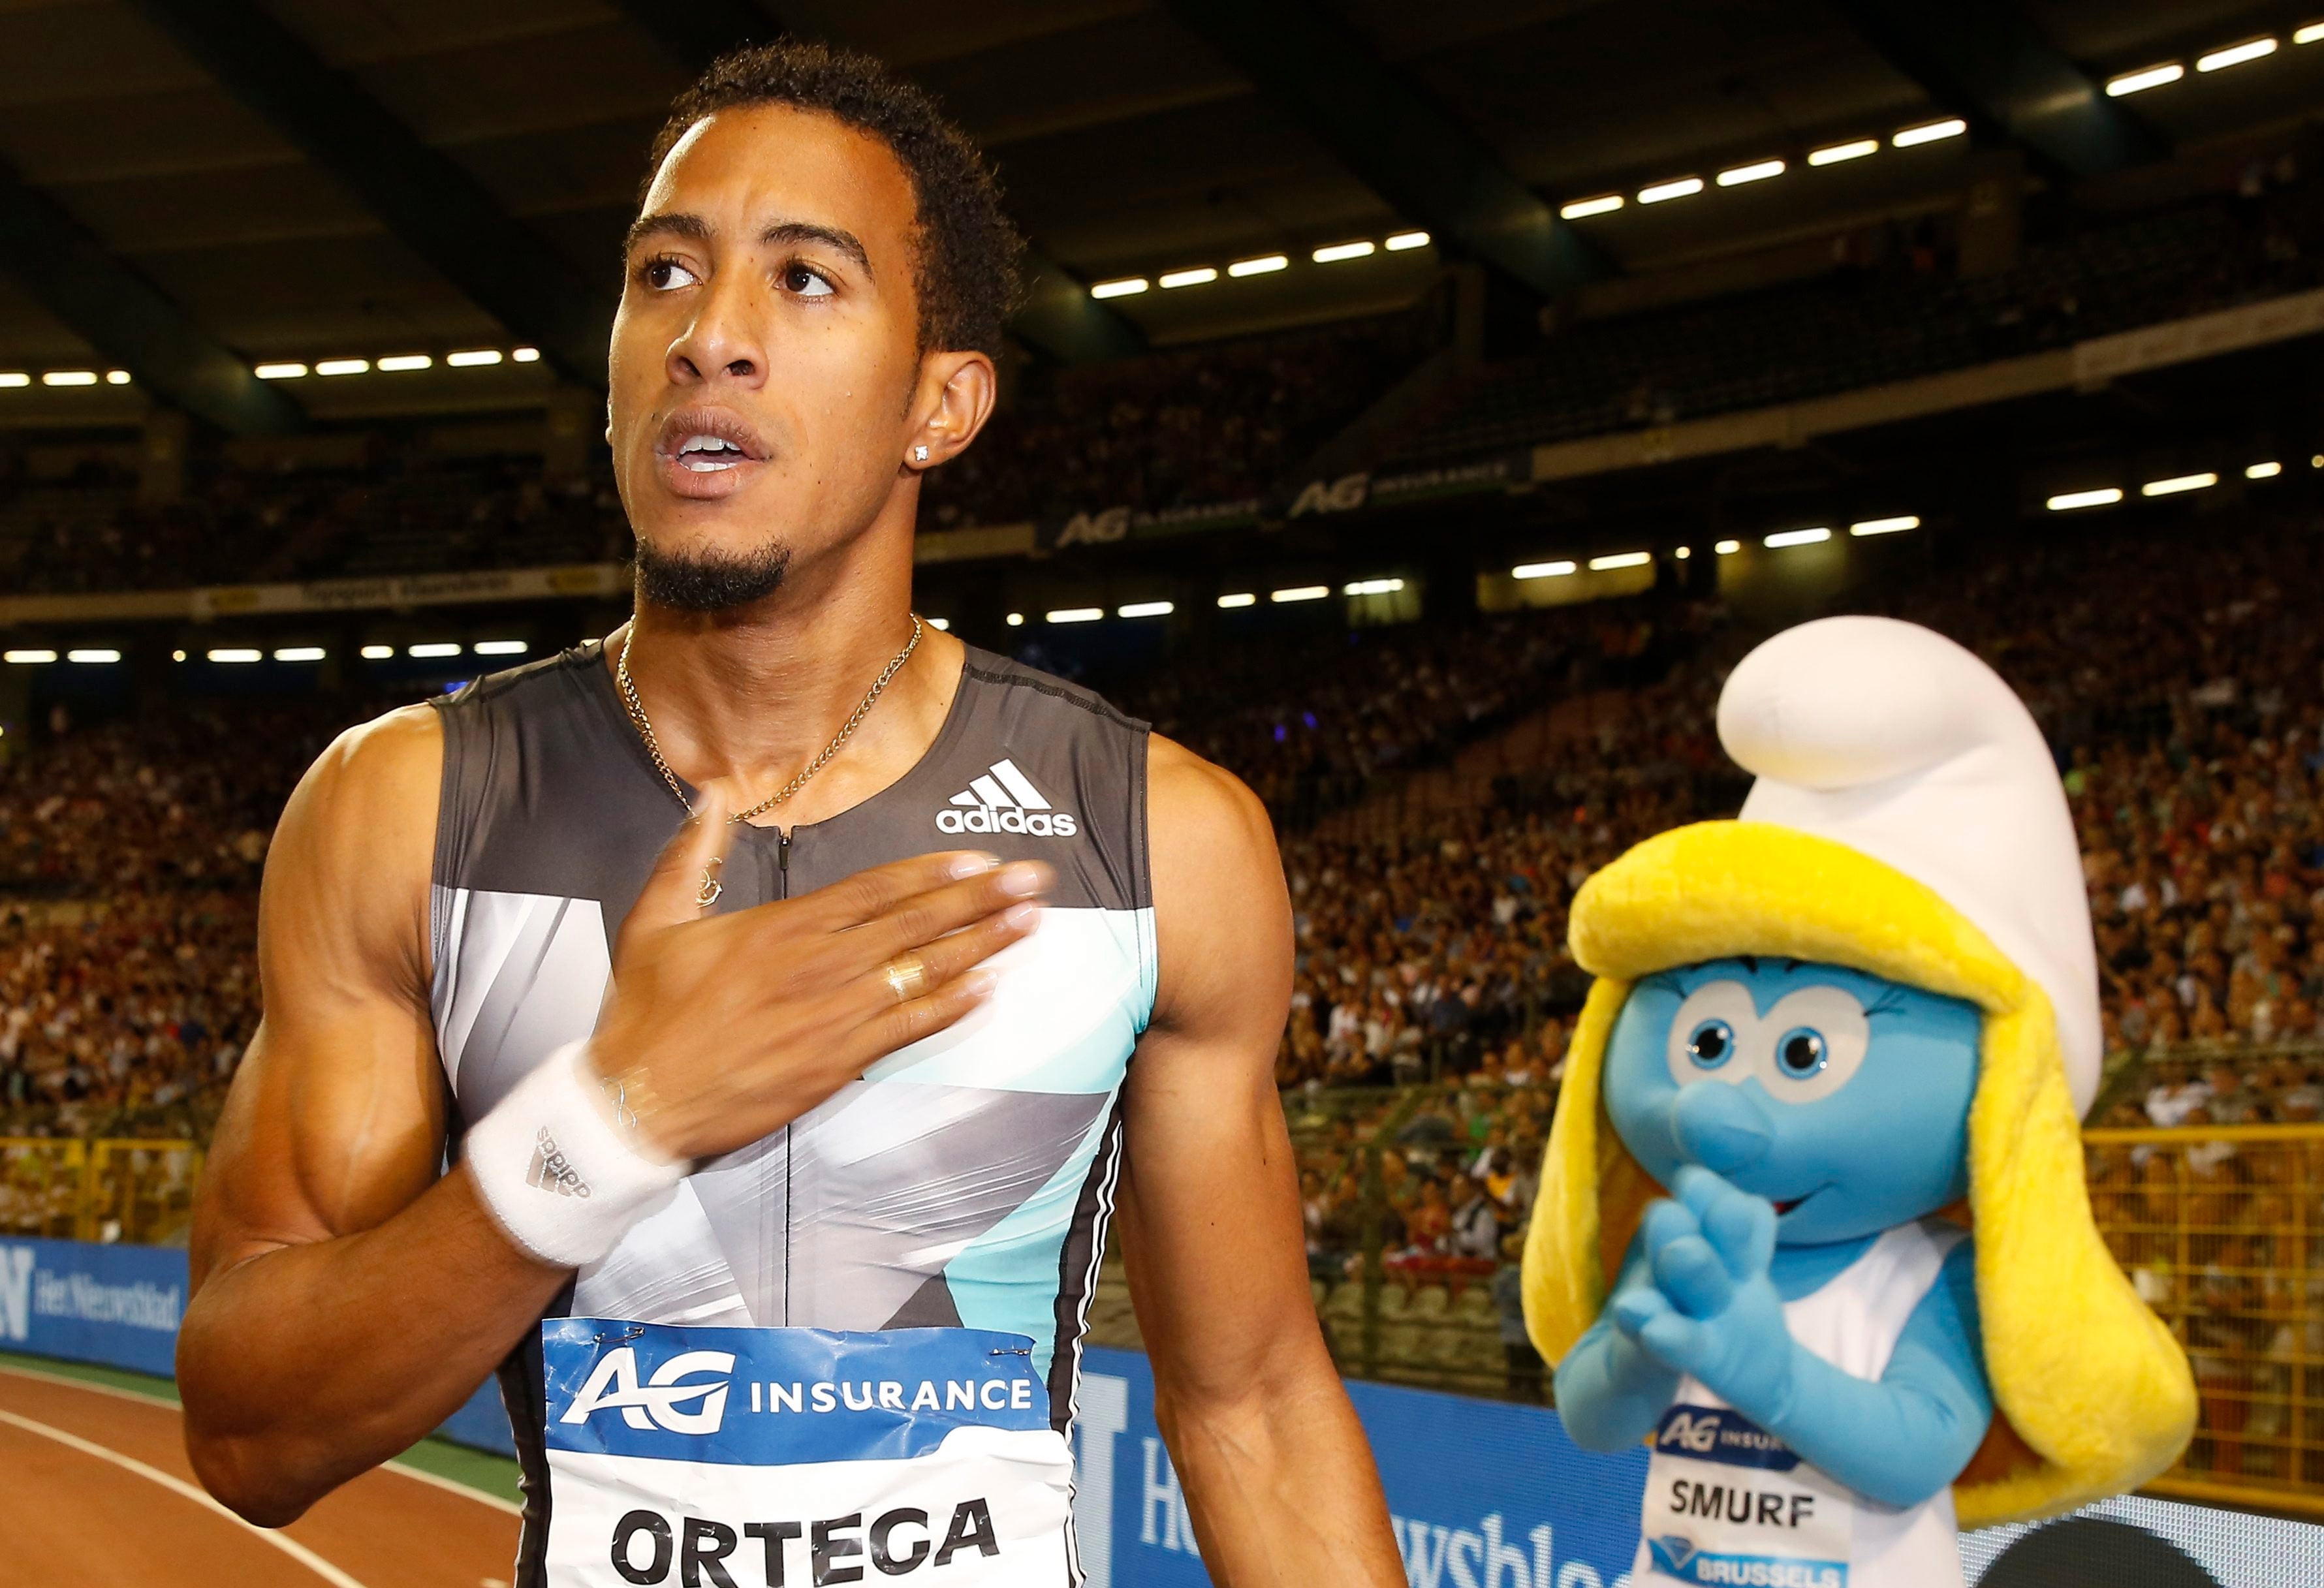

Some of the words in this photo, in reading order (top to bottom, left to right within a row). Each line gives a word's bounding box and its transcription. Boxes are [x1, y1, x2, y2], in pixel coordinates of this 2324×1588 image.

[1286, 471, 1370, 519] AG
[1054, 505, 1131, 549] AG
[935, 804, 1078, 837] adidas
[537, 1126, 591, 1198] adidas
[559, 1347, 736, 1435] AG
[750, 1378, 1033, 1414] INSURANCE
[1660, 1412, 1721, 1453] AG
[1720, 1430, 1783, 1451] INSUR
[1670, 1479, 1814, 1528] SMURF
[611, 1497, 1000, 1588] ORTEGA
[1697, 1558, 1840, 1588] BRUSSELS
